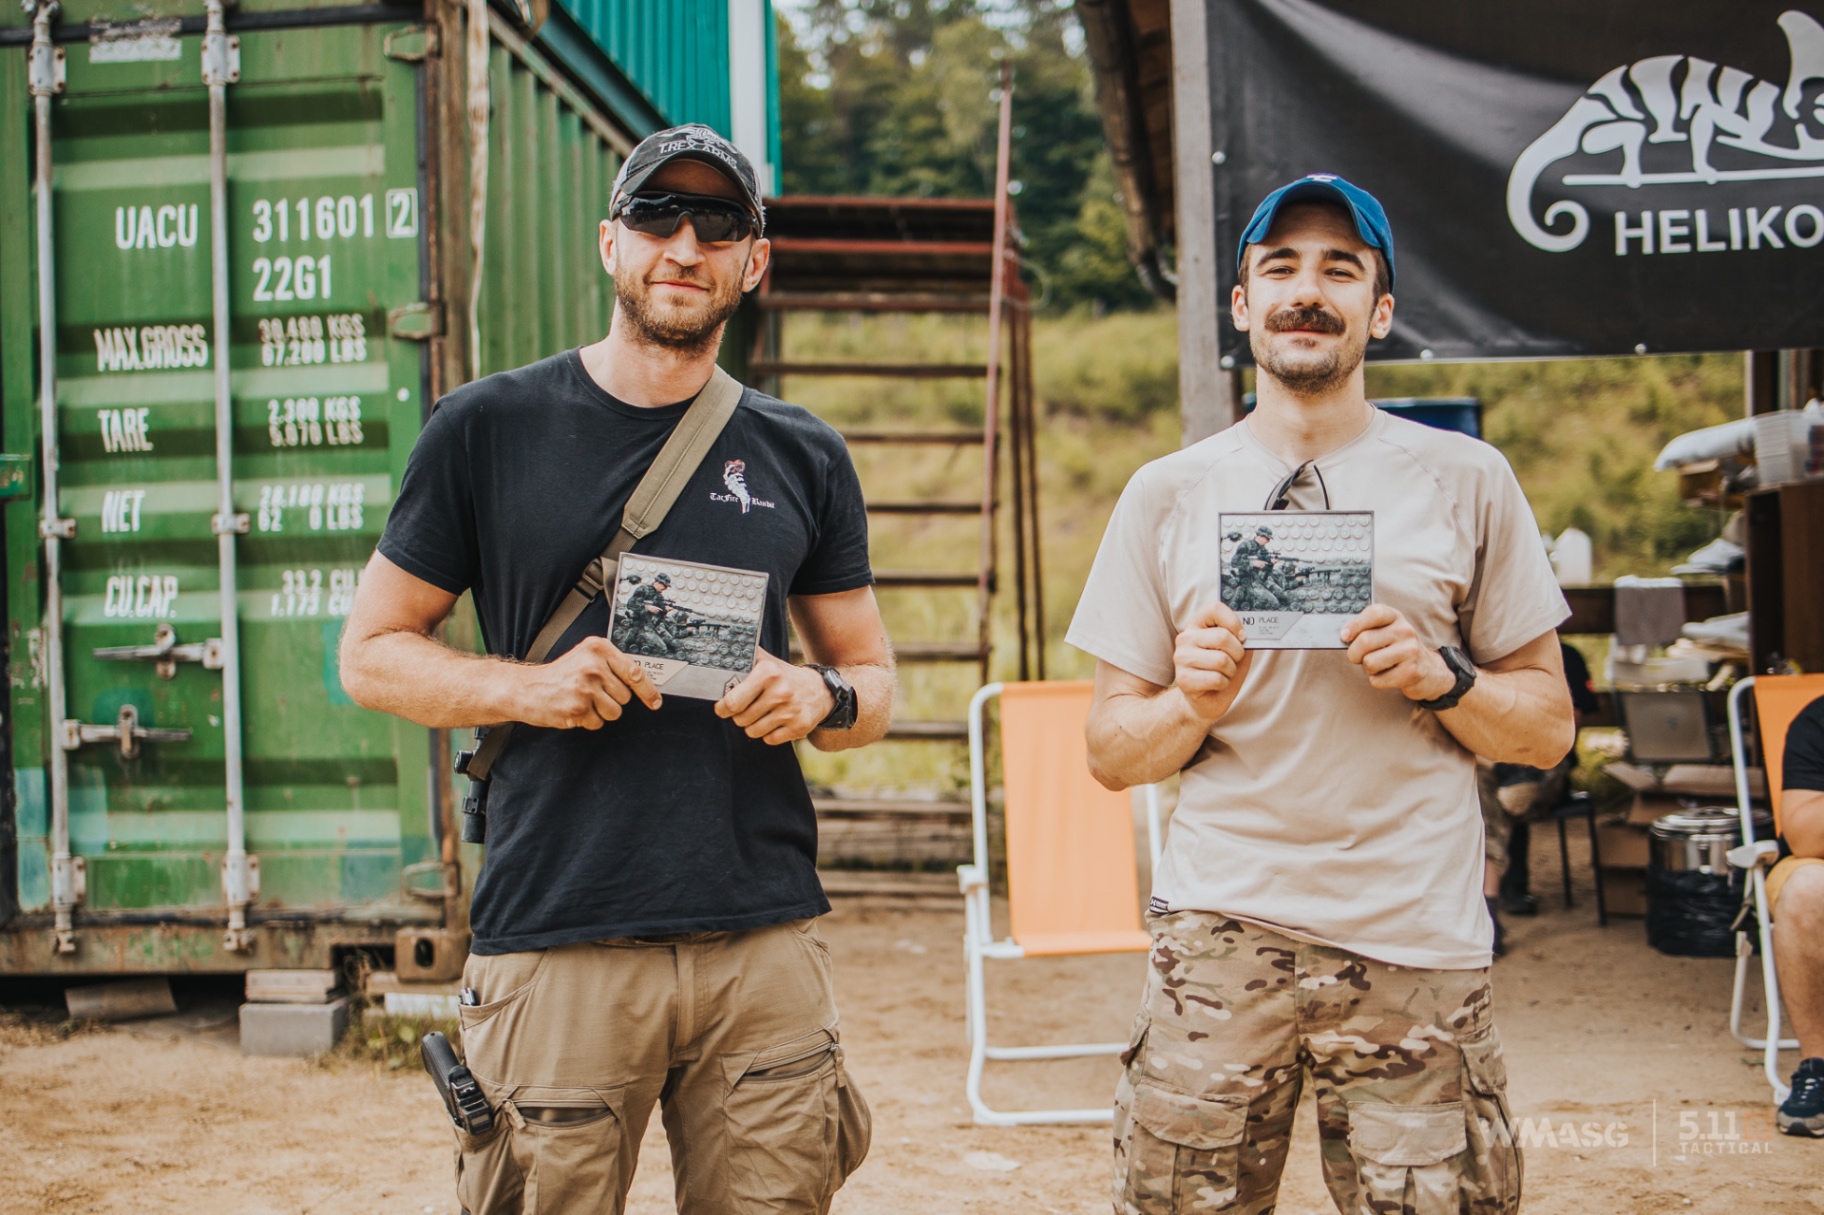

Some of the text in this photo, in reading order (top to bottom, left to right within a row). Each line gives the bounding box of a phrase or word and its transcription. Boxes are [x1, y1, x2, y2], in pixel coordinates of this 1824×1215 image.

[115, 190, 414, 250] UACU 311601 2
[1614, 204, 1824, 256] HELIKO
[252, 255, 332, 302] 22G1
[327, 312, 366, 339] KGS
[330, 336, 367, 362] LBS
[324, 396, 361, 421] KGS
[326, 420, 364, 445] LBS
[101, 489, 146, 533] NET
[327, 482, 365, 506] KGS
[326, 504, 364, 530] LBS
[644, 661, 665, 671] PLACE
